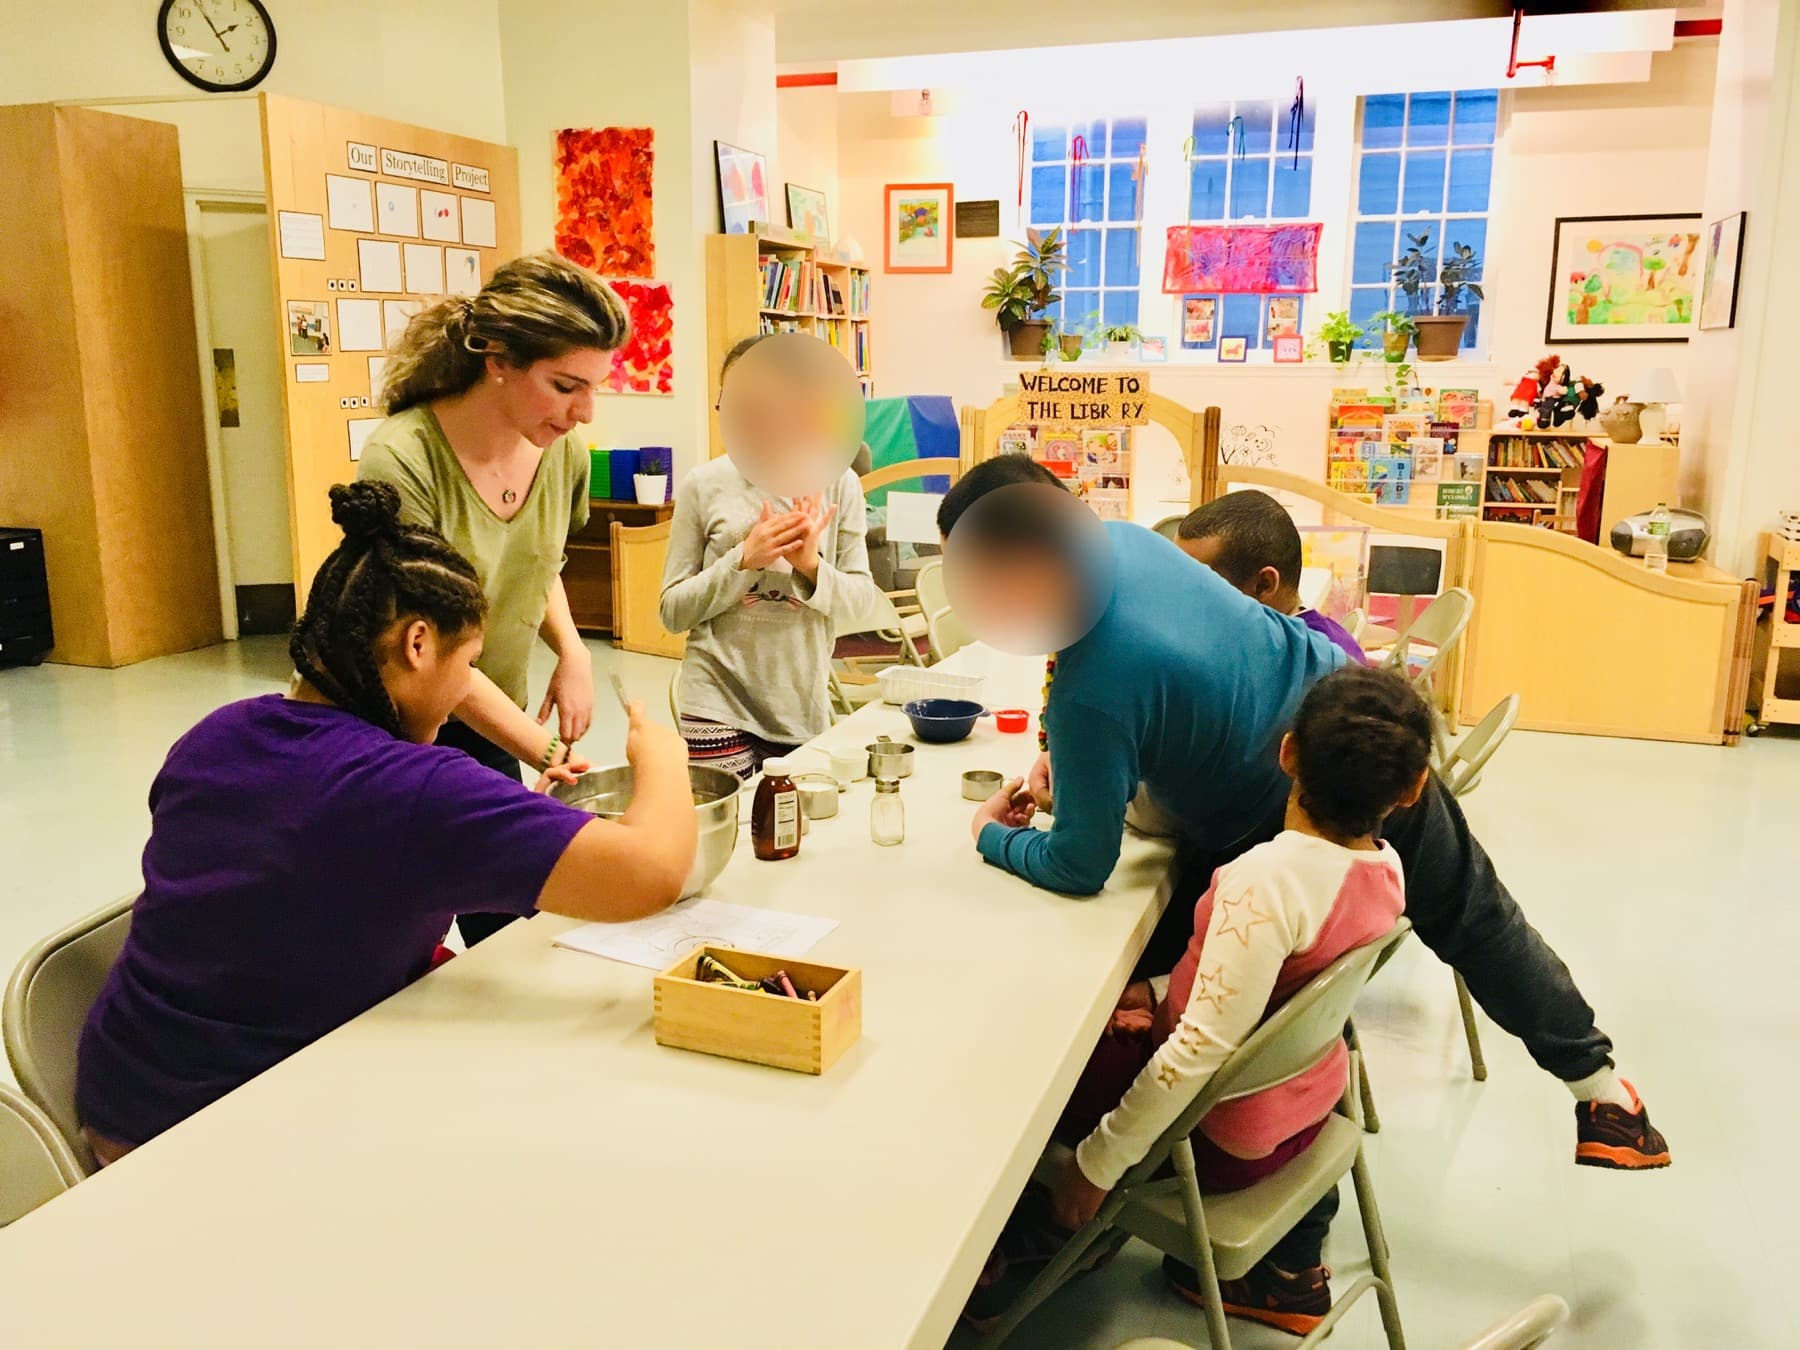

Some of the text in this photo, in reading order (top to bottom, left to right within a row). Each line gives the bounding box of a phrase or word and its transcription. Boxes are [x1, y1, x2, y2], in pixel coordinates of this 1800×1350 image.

[179, 8, 191, 18] 10
[245, 15, 253, 27] 2
[176, 26, 185, 36] 9
[197, 59, 205, 70] 7
[215, 66, 224, 77] 6
[351, 146, 488, 187] Our Storytelling Project
[1020, 373, 1140, 395] WELCOME TO
[1027, 401, 1063, 420] THE
